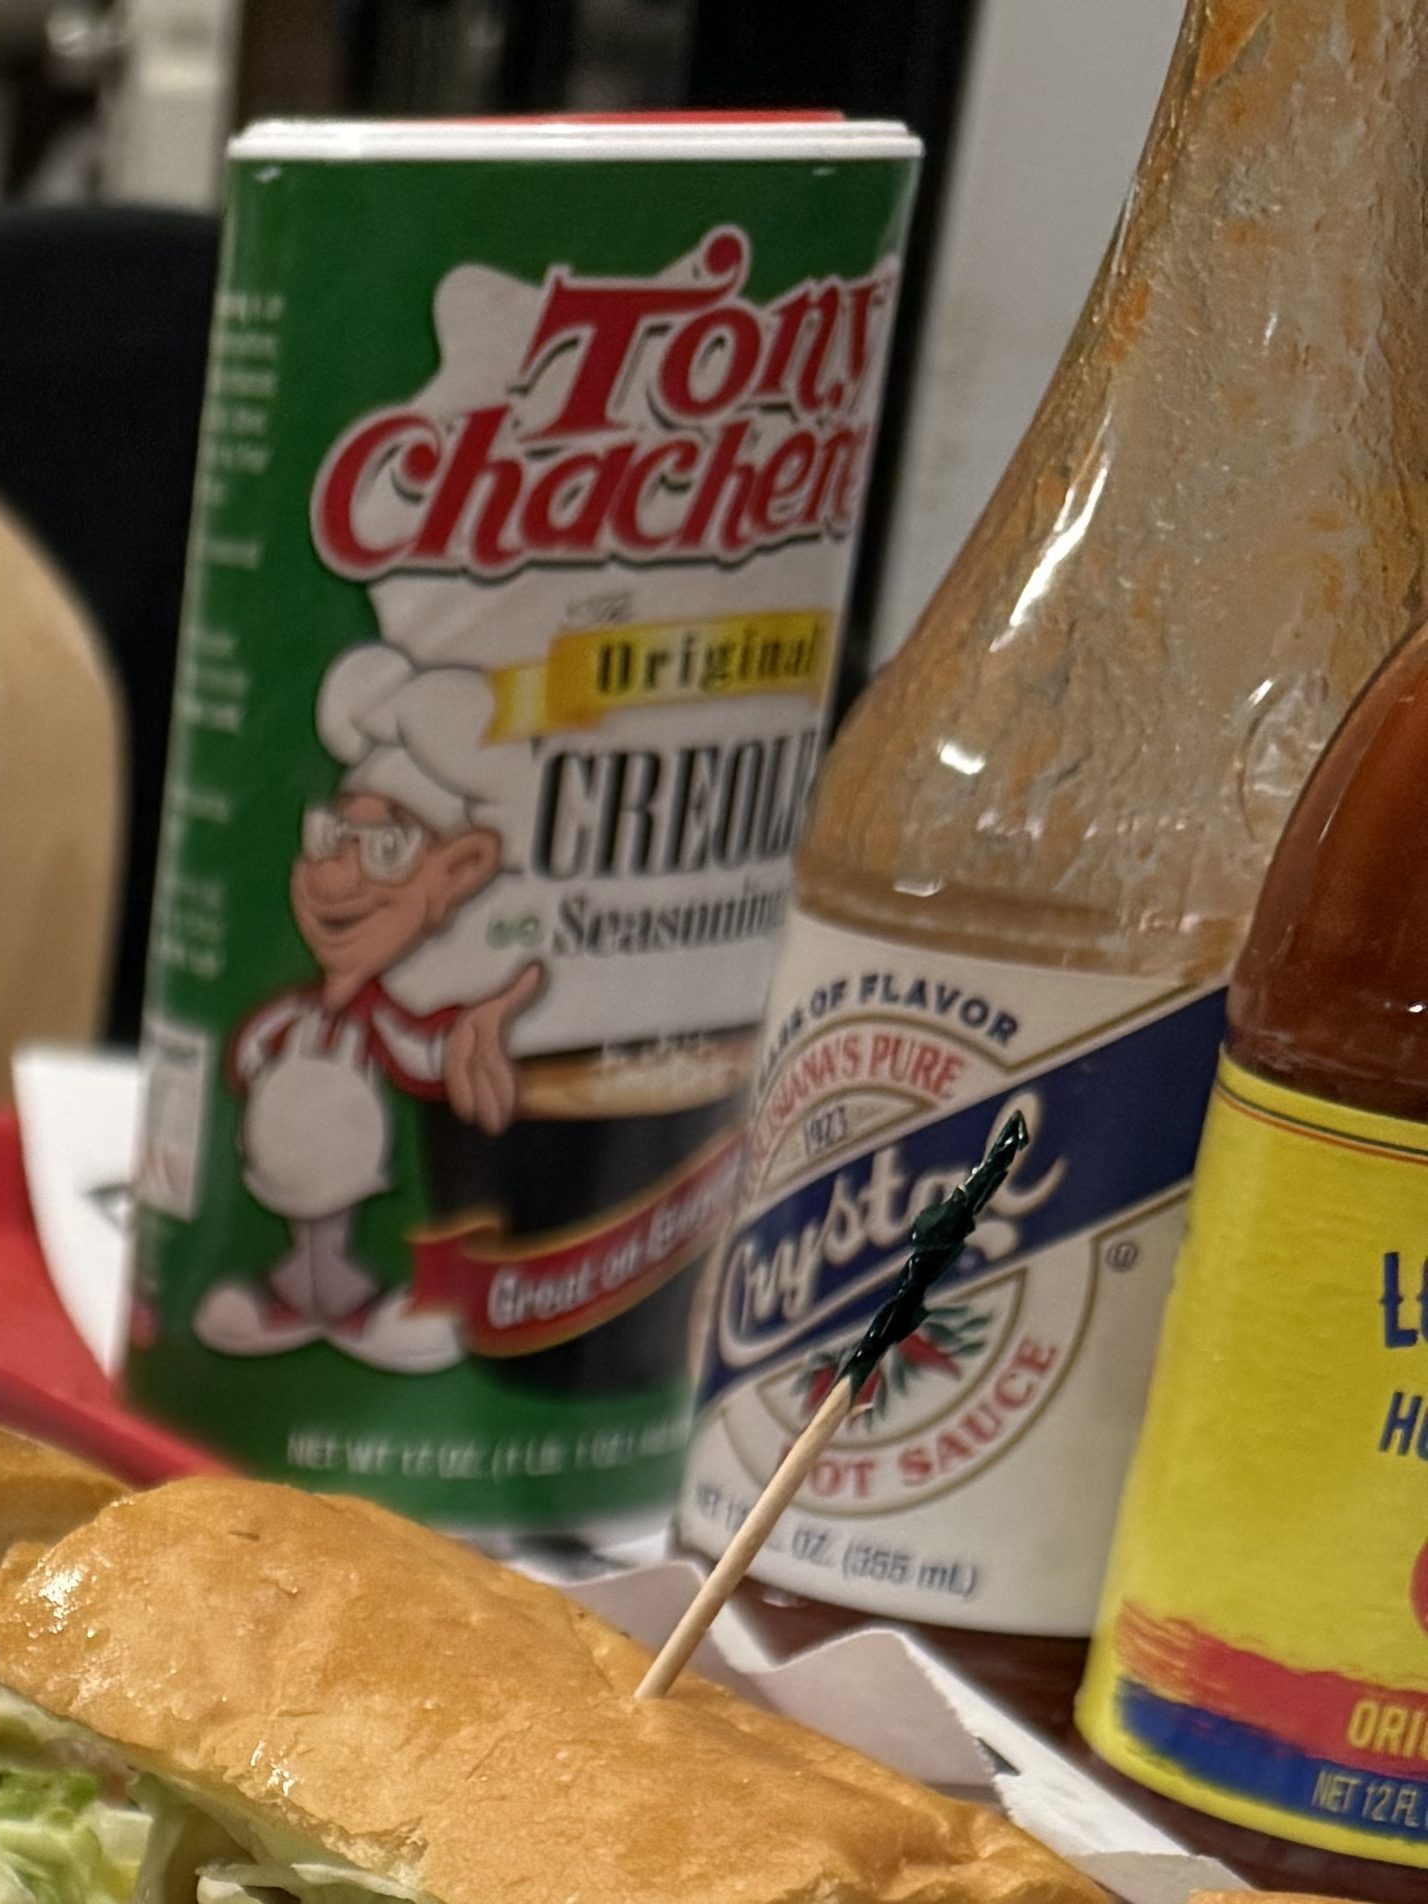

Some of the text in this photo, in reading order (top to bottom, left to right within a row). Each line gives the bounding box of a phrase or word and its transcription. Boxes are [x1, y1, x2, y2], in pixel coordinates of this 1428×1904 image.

[596, 622, 820, 696] Original
[809, 972, 1021, 1047] OF FLAVOR
[868, 1032, 967, 1102] PURE
[898, 1336, 1056, 1486] SAUCE
[1312, 1768, 1362, 1814] NET
[1362, 1780, 1392, 1822] 12
